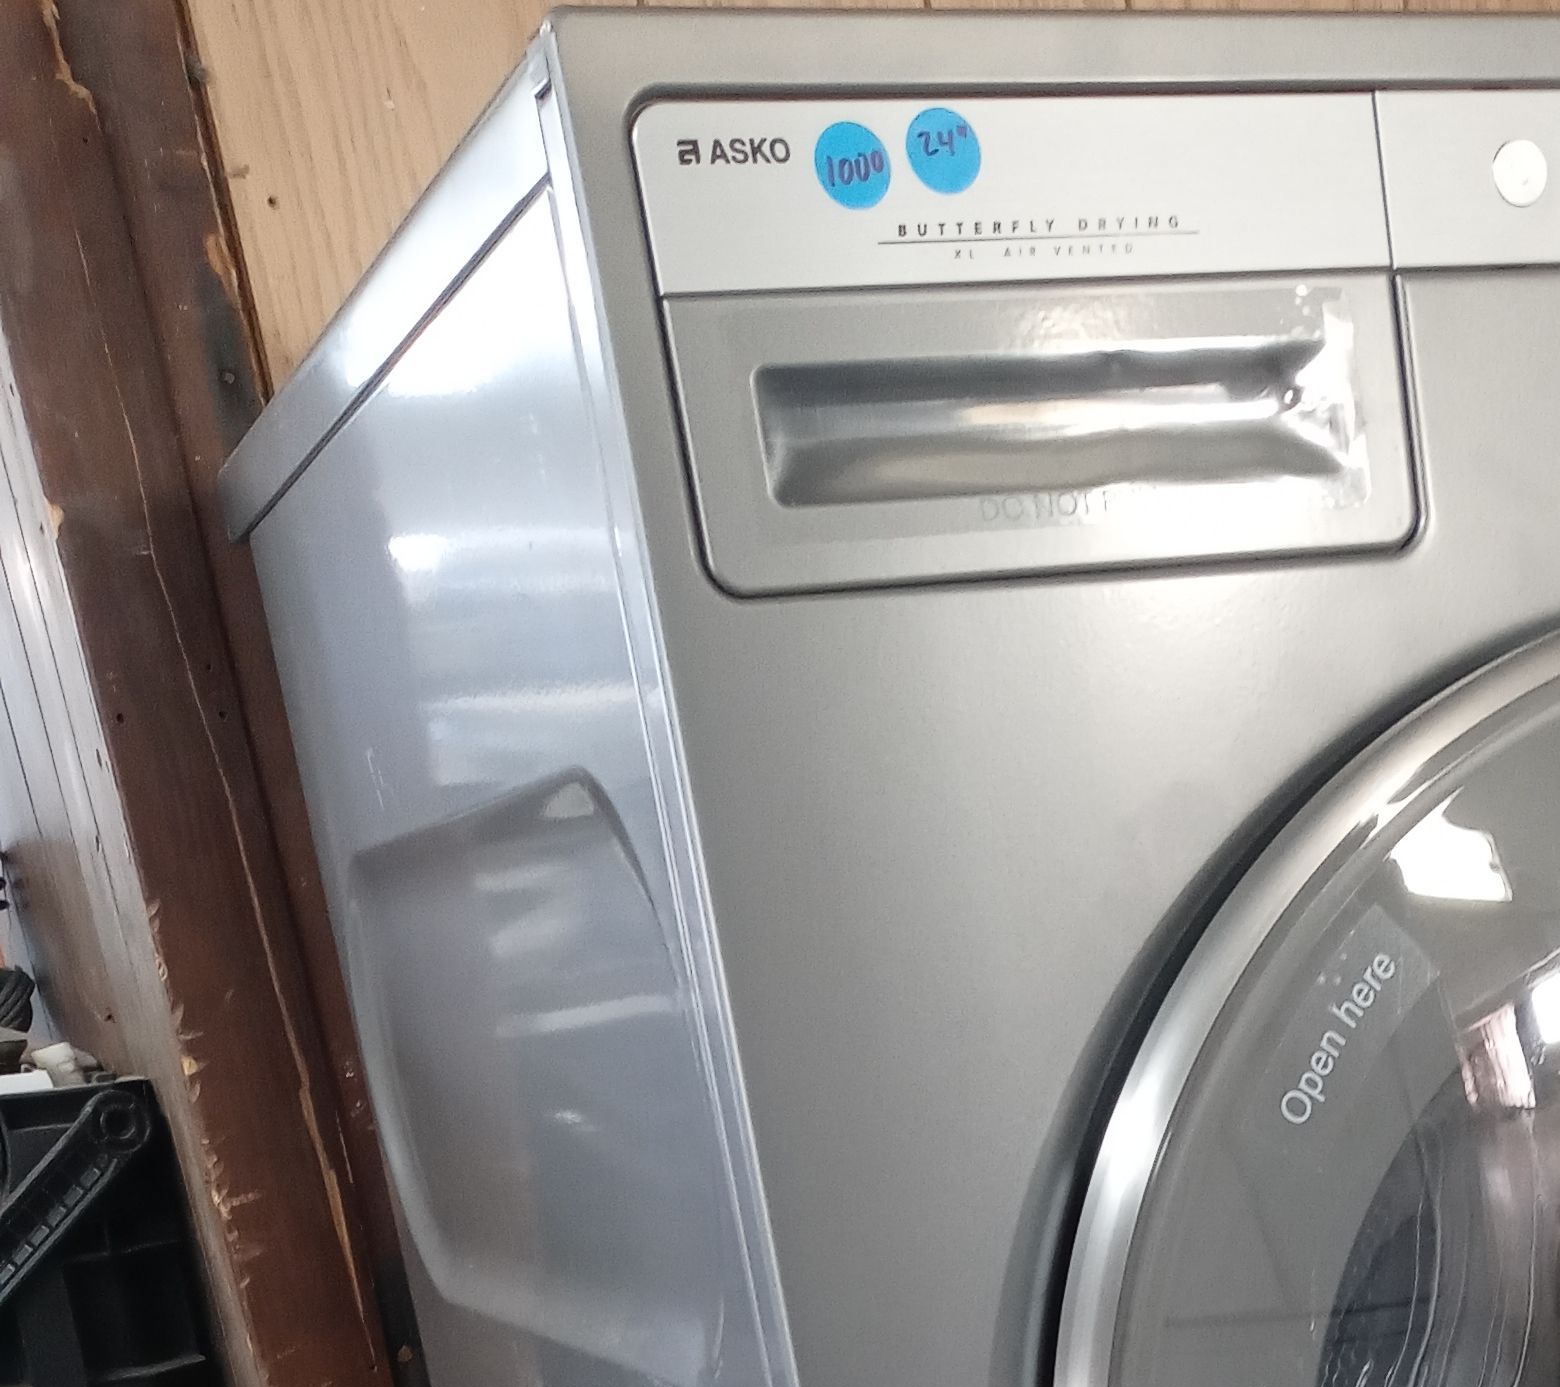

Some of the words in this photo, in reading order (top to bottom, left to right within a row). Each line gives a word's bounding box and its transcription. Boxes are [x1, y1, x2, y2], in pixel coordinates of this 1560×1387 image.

[709, 137, 792, 165] ASKO
[826, 149, 885, 188] 1000
[897, 218, 1056, 238] BUTTERFLY
[1077, 215, 1180, 232] DRYING
[1281, 1030, 1346, 1124] Open
[1328, 953, 1396, 1029] here
